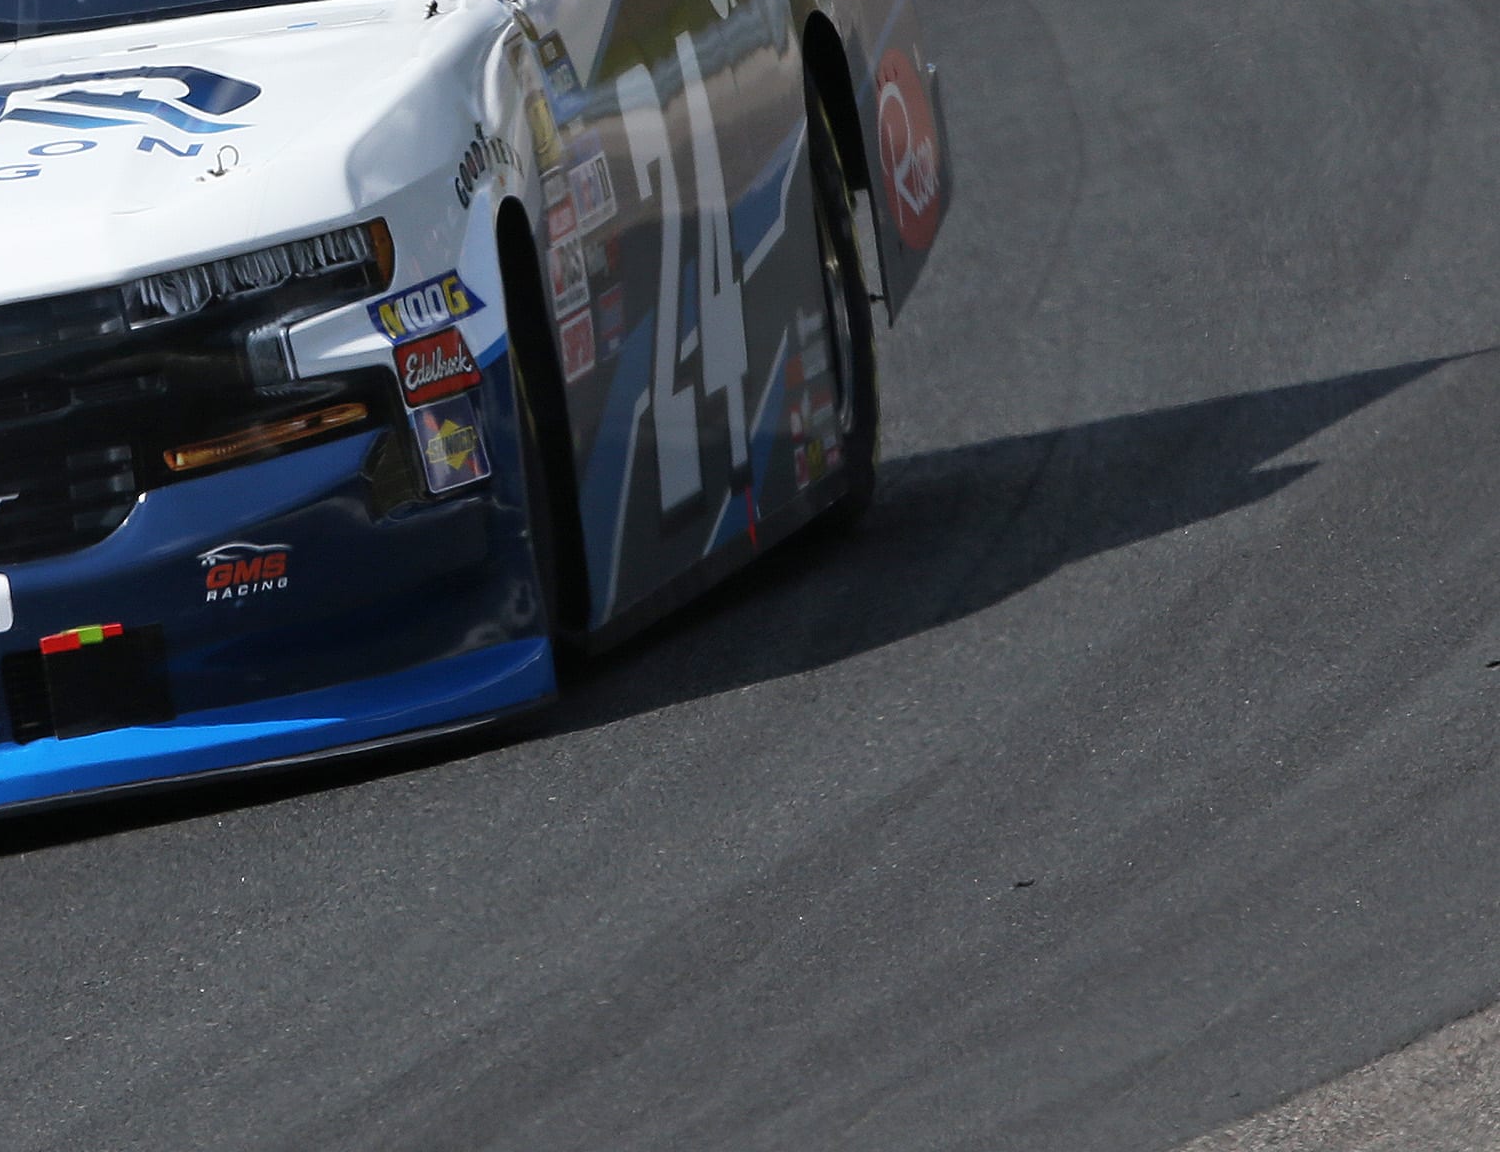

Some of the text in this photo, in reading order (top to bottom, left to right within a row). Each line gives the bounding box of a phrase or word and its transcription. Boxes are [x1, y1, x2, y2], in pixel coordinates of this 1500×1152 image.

[616, 31, 749, 516] 24
[378, 275, 471, 340] MOOG
[404, 343, 474, 391] Edelbrock
[205, 552, 287, 590] GMS
[205, 576, 288, 603] RACING
